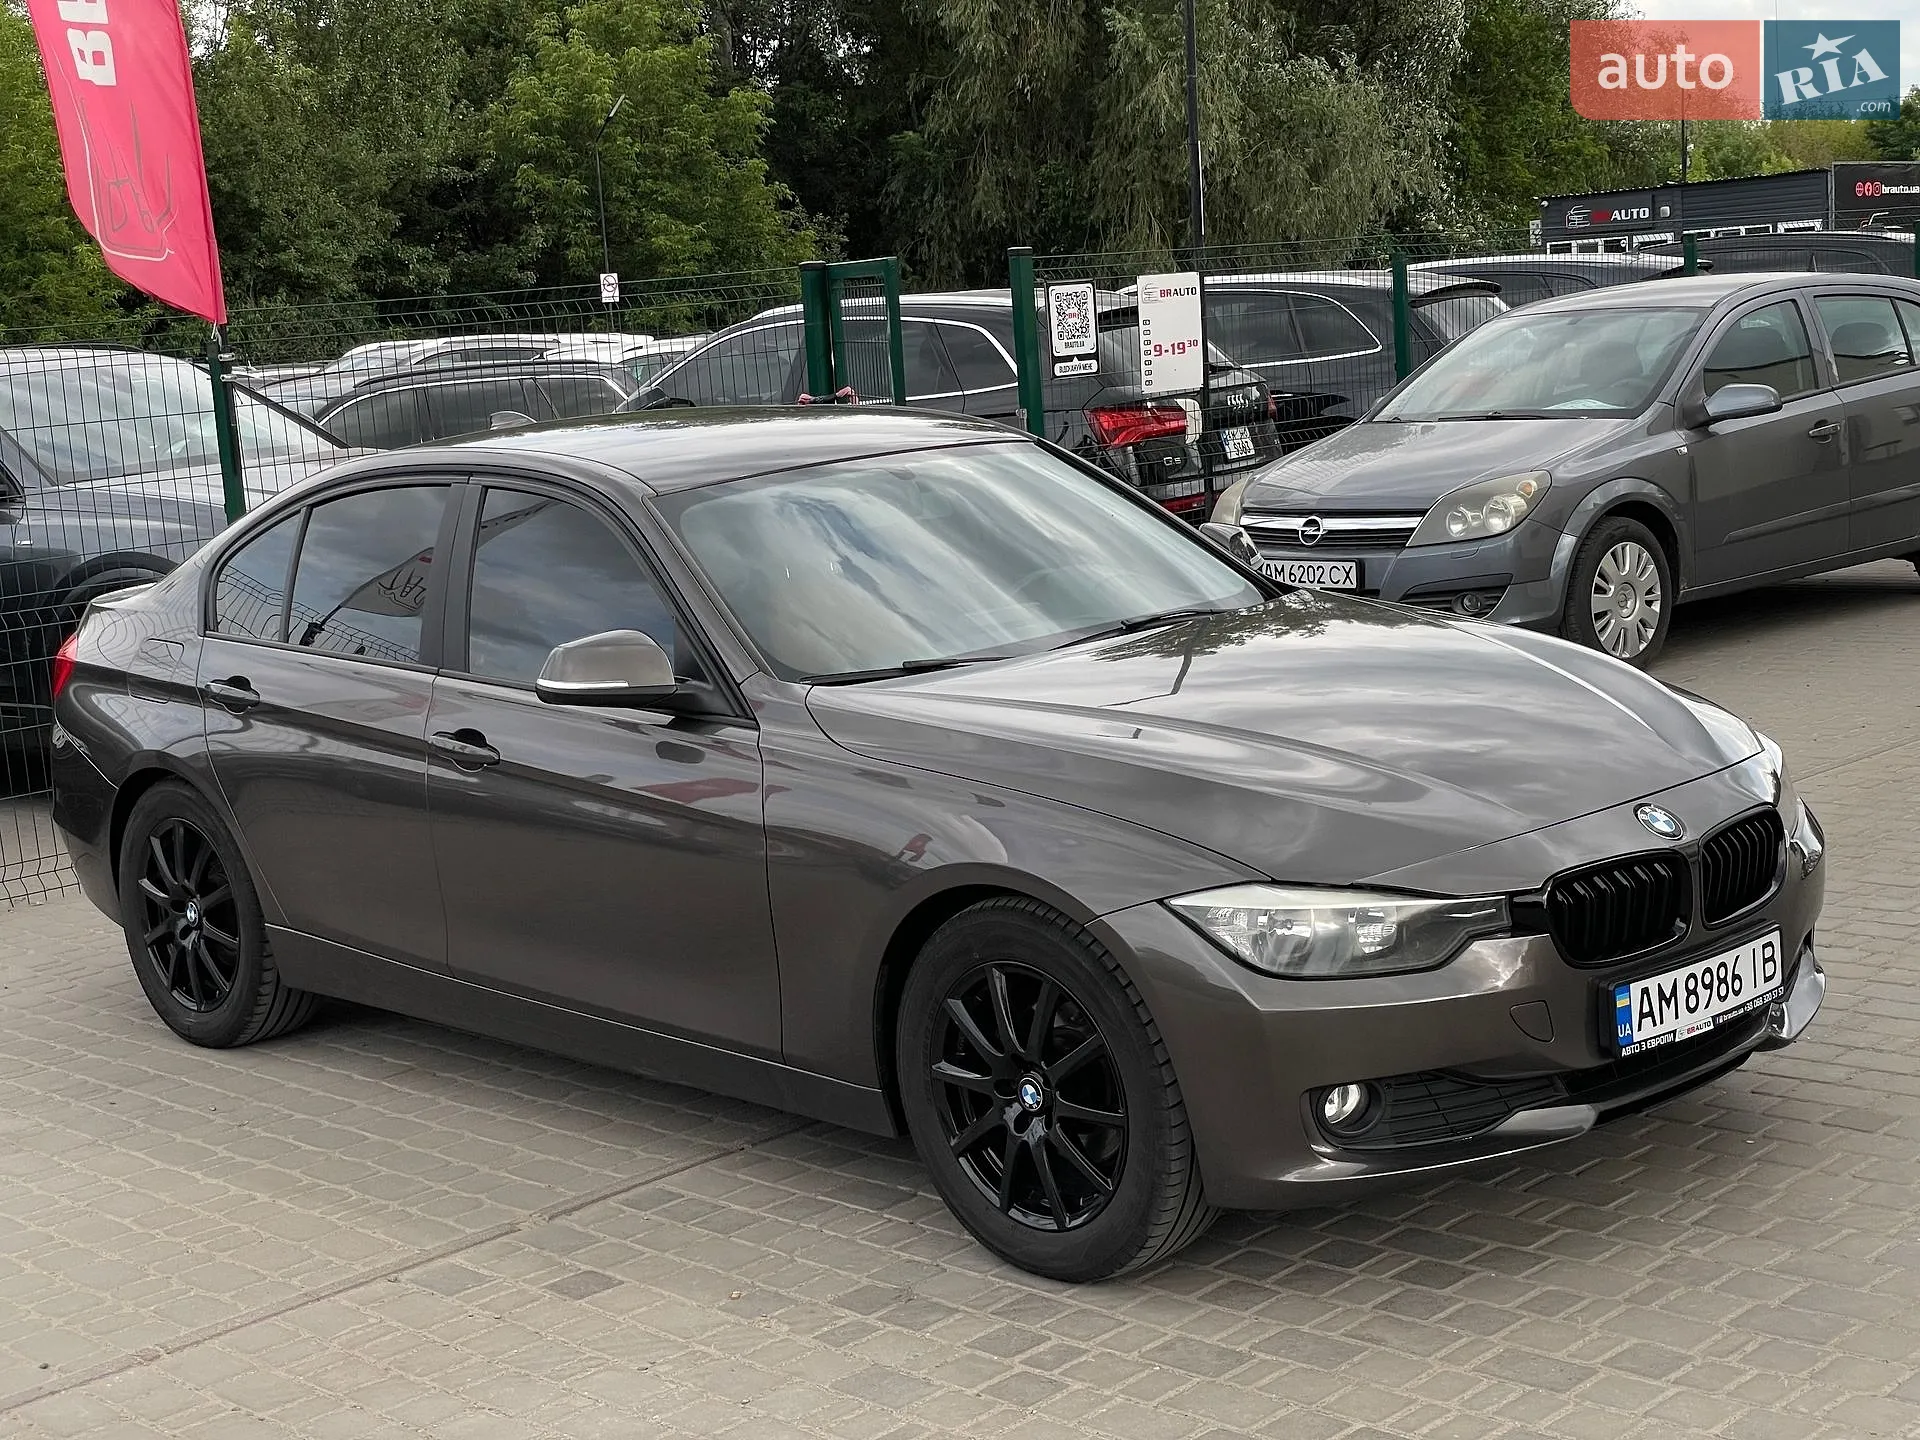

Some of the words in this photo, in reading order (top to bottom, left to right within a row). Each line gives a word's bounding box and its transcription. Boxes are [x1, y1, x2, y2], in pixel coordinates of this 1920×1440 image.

[1882, 184, 1920, 194] brauto.ua
[1160, 286, 1197, 298] BRAUTO
[1637, 977, 1680, 1032] AM
[1684, 954, 1743, 1014] 8986
[1752, 940, 1777, 989] IB
[1617, 1022, 1632, 1037] UA
